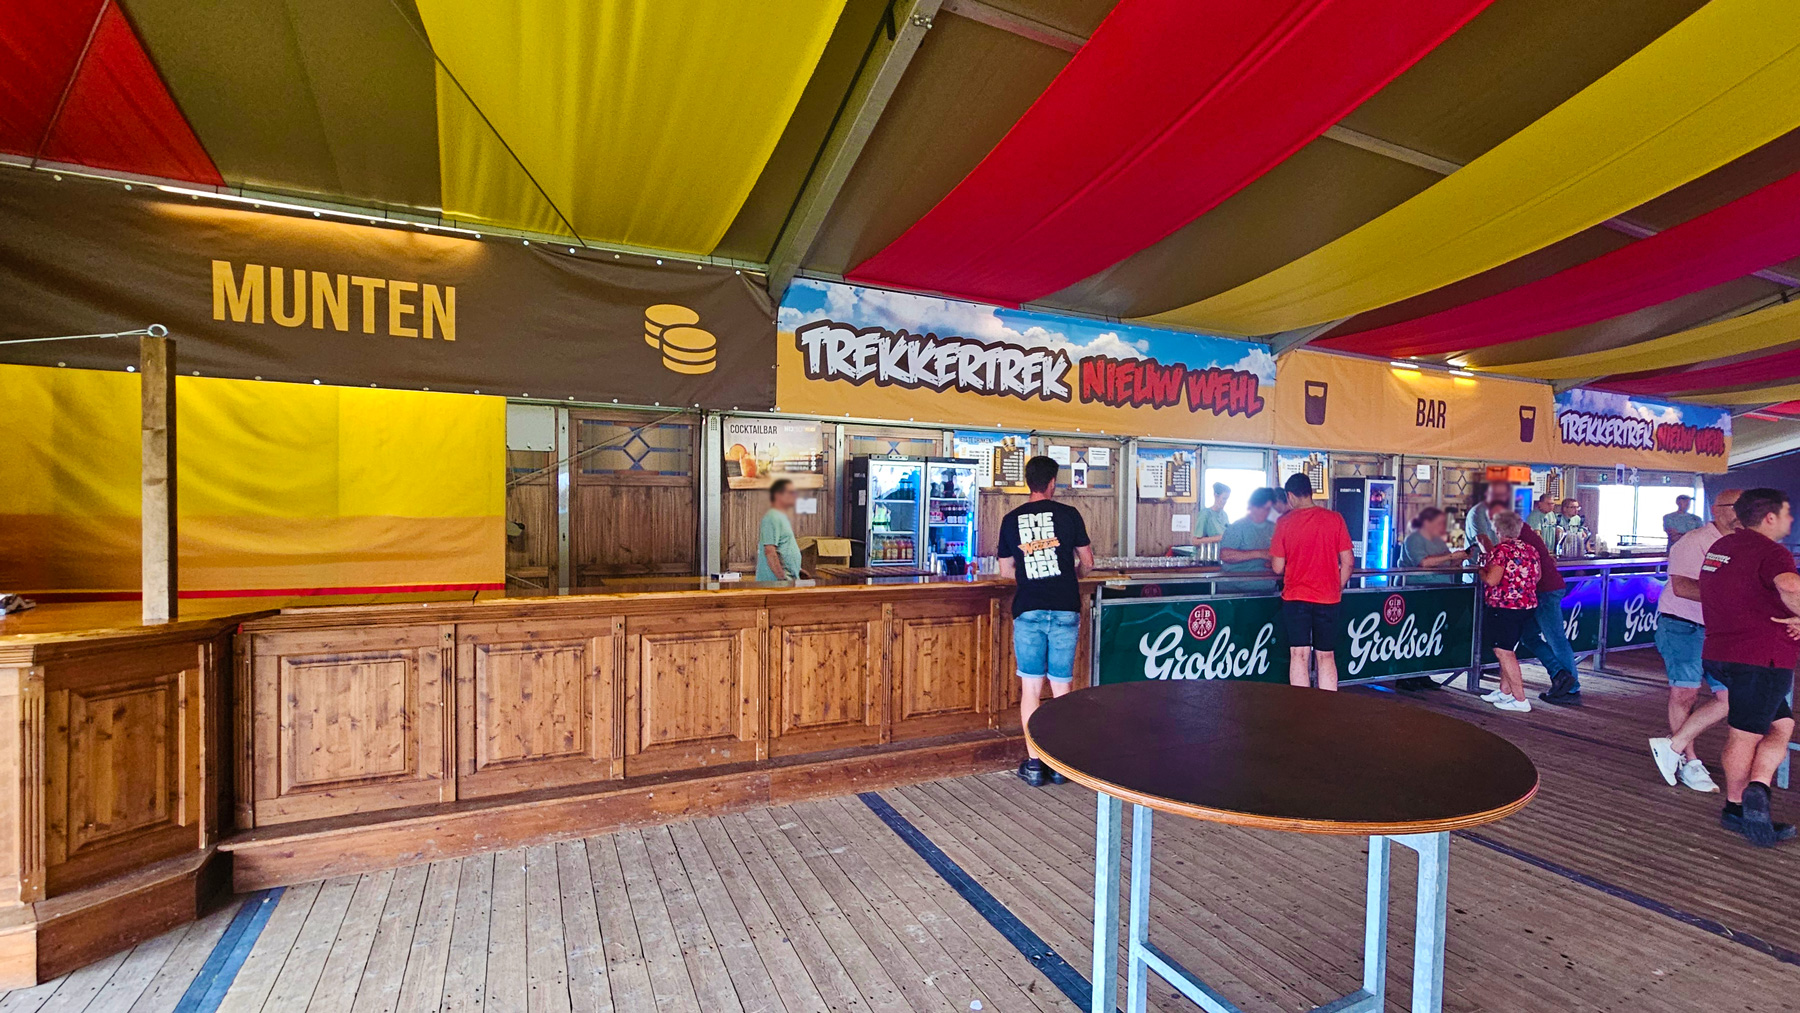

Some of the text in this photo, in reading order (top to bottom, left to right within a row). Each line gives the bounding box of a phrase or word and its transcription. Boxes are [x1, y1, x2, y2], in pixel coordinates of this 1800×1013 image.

[212, 260, 456, 341] MUNTEN
[800, 325, 1264, 414] TREKKERTREK NIEUW WEHL
[730, 424, 778, 434] COCKTAILBAR
[1416, 398, 1447, 429] BAR
[1560, 412, 1655, 450] TREKKERTREK
[1017, 512, 1054, 529] SME
[1025, 560, 1062, 580] KER
[1139, 622, 1274, 680] Grolsch
[1347, 610, 1447, 675] Grolsch
